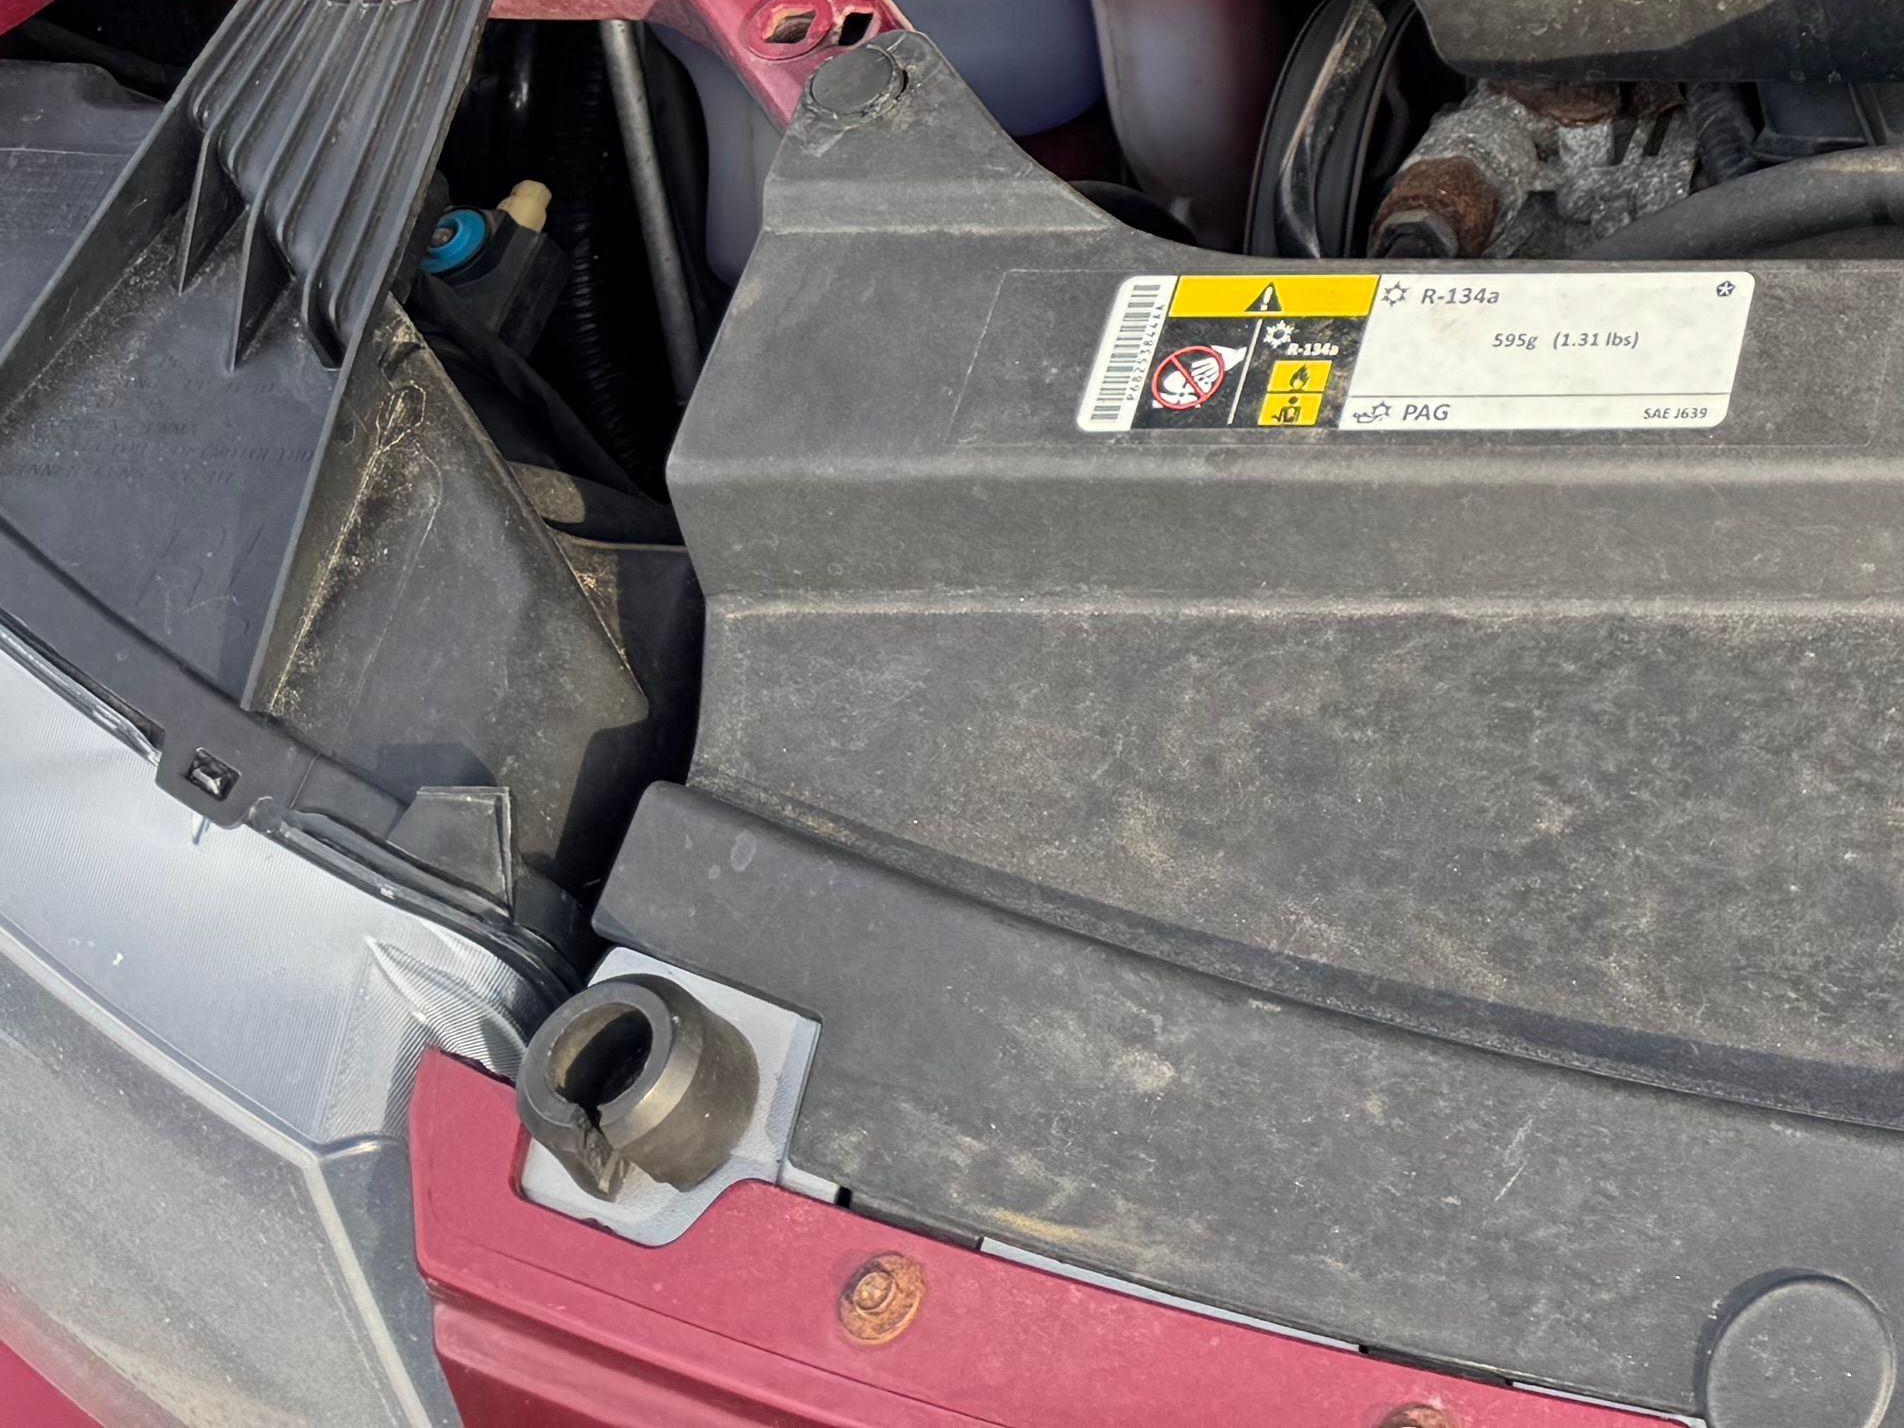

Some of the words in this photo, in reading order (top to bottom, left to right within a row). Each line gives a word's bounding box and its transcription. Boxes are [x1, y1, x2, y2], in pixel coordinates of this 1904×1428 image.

[1421, 286, 1500, 306] R-134a
[1491, 332, 1538, 350] 595g
[1552, 330, 1599, 351] (1.31
[1603, 330, 1639, 351] lbs)
[1401, 403, 1449, 422] PAG
[1642, 406, 1673, 420] SAE
[1675, 406, 1708, 420] J639
